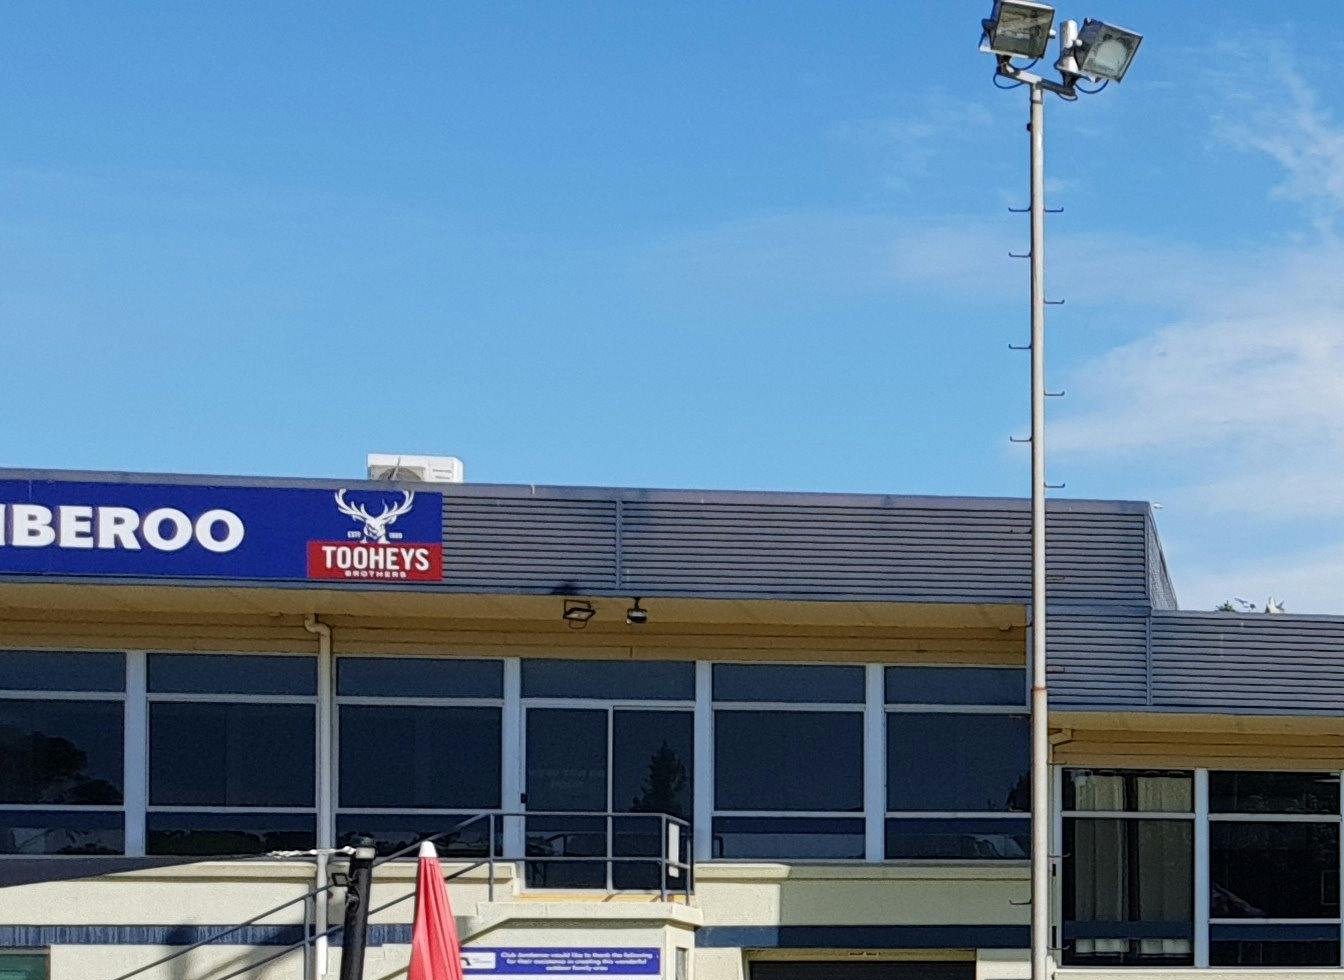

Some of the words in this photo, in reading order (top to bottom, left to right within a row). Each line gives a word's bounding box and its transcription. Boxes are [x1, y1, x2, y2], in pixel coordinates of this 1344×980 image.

[0, 504, 245, 552] BEROO
[322, 546, 429, 571] TOOHEYS
[345, 570, 406, 578] BROTHERS
